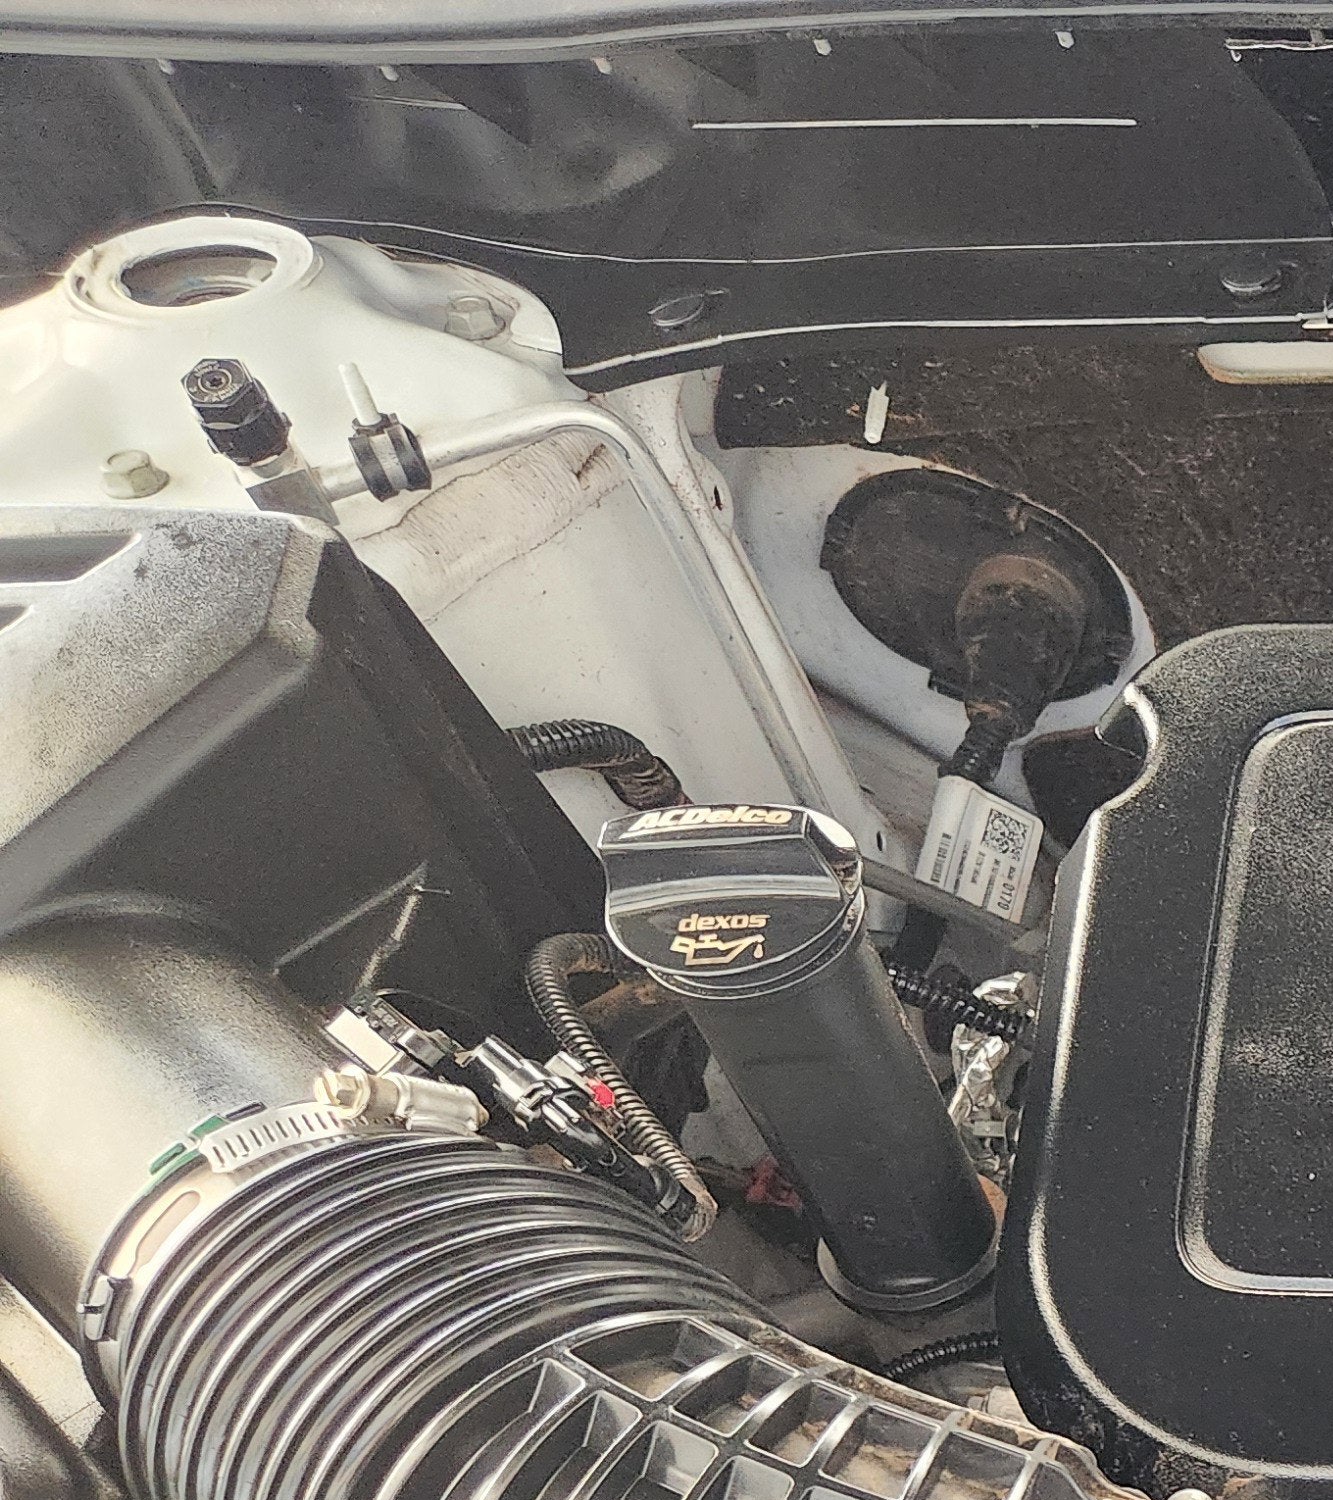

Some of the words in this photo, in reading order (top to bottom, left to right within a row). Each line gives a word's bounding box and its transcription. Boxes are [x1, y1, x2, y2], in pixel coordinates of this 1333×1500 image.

[627, 806, 793, 832] ACDelco
[997, 882, 1014, 912] 0170
[678, 914, 770, 931] dexos
